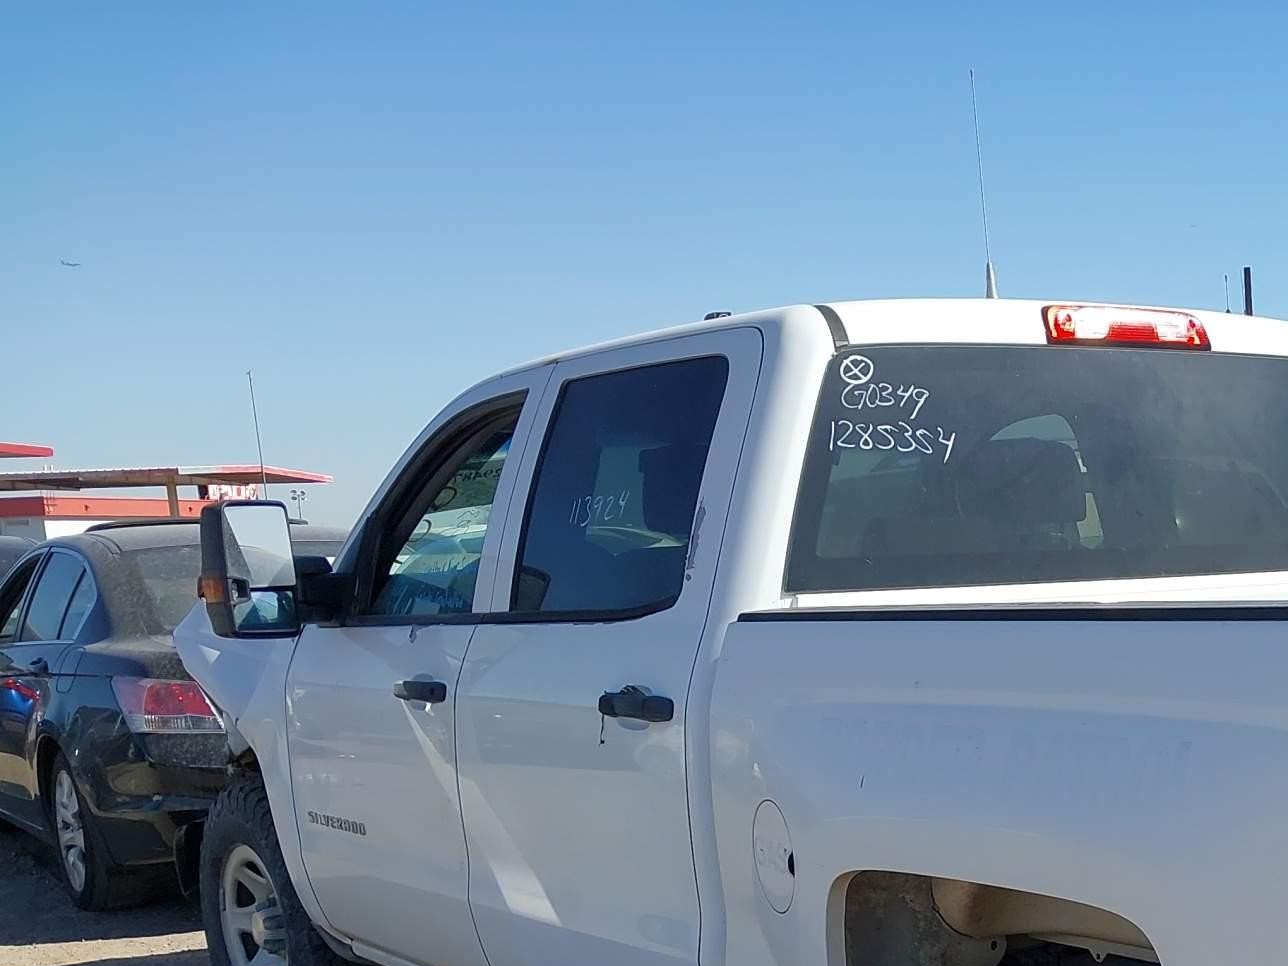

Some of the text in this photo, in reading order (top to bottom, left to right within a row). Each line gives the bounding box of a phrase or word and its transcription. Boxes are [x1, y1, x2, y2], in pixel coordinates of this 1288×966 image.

[829, 420, 956, 464] 1285354
[569, 490, 630, 527] 113924
[307, 811, 366, 836] SILVERADO
